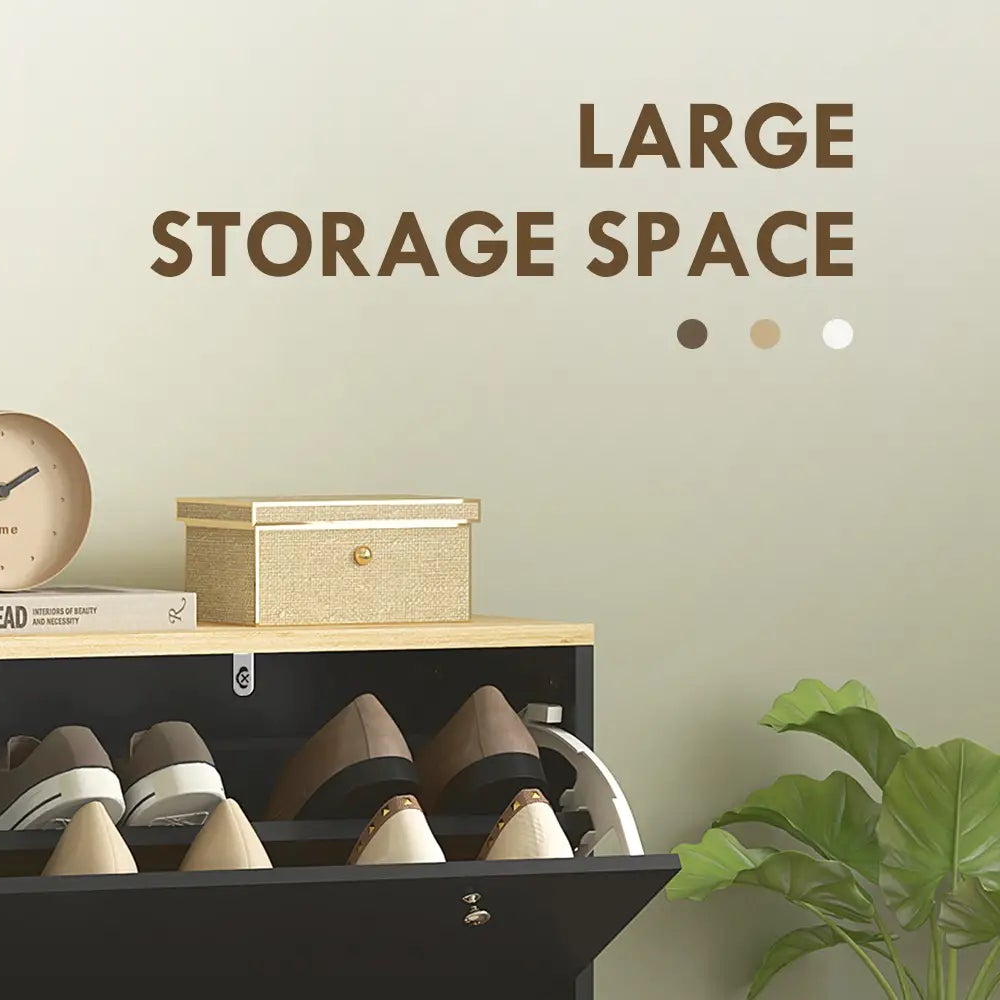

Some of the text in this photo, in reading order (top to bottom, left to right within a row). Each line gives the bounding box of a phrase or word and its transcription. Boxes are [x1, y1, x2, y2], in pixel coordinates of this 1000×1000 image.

[32, 606, 98, 616] INTERIORS OF BEAUTY
[32, 617, 80, 627] AND NECESSITY
